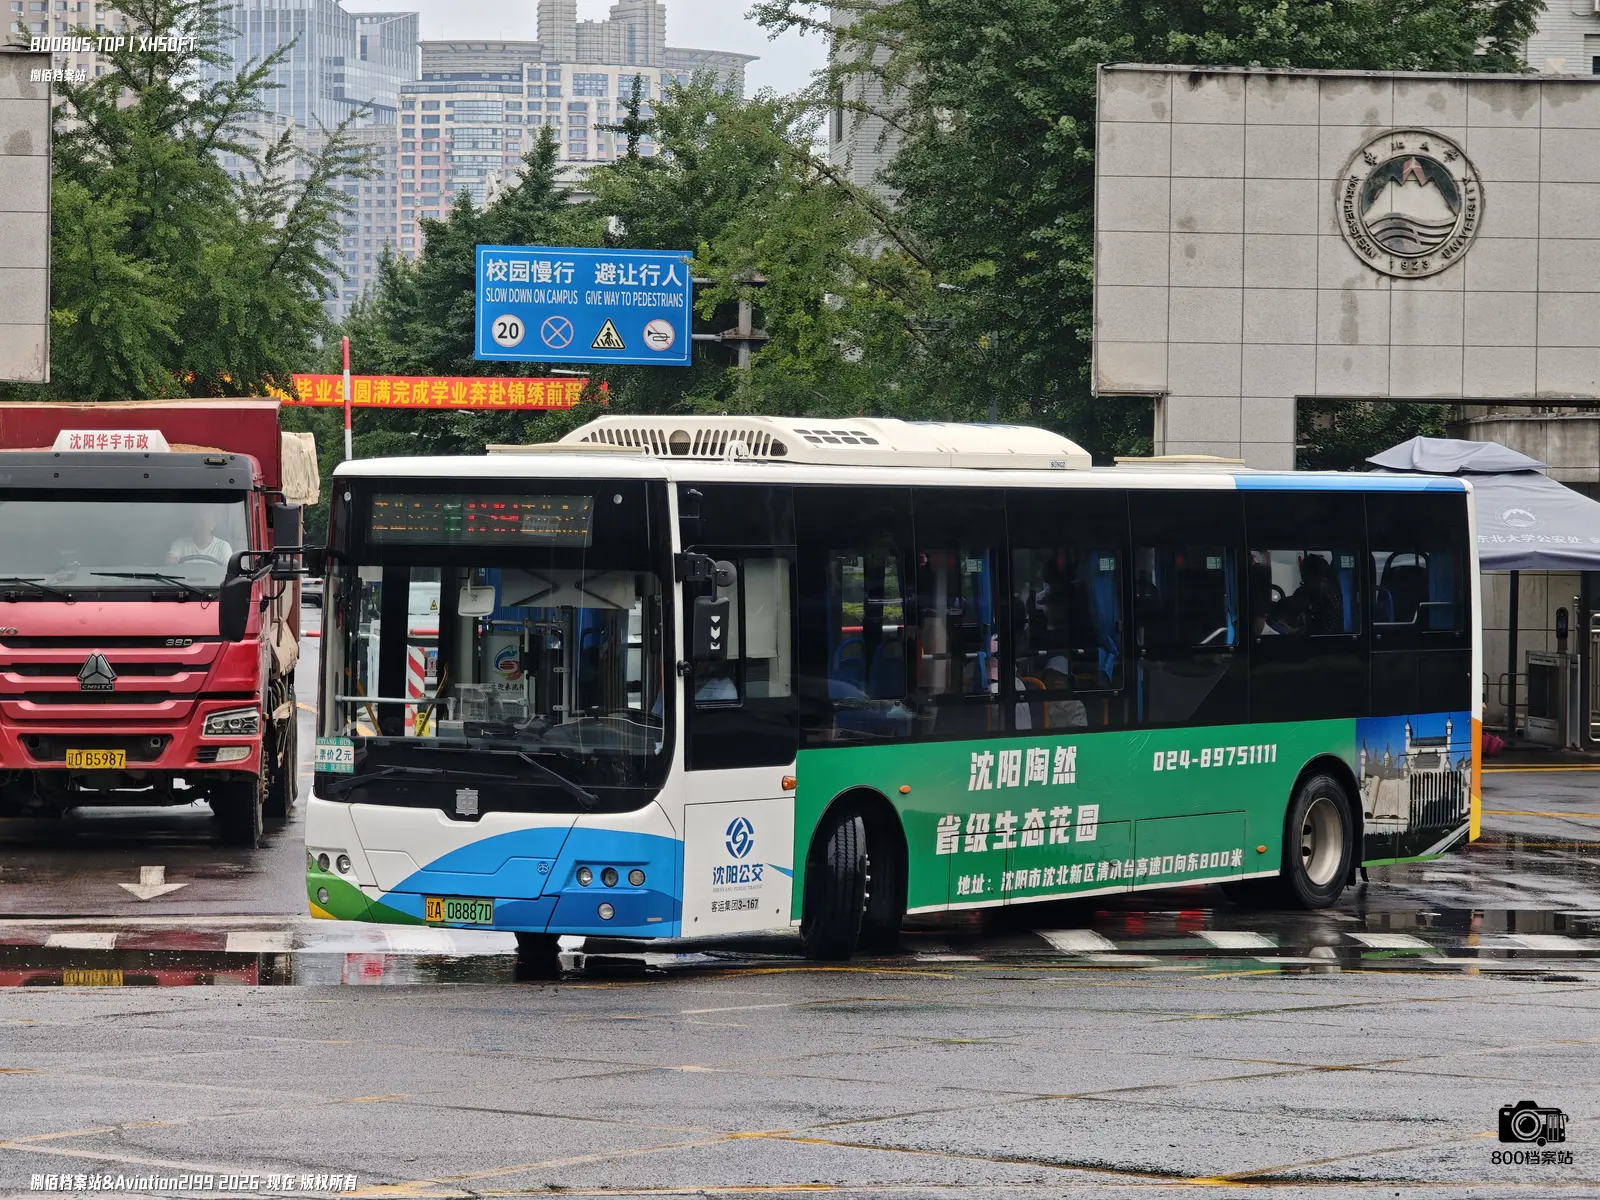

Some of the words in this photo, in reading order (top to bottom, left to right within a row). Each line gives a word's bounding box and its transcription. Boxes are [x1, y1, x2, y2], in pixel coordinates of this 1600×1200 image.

[486, 258, 575, 284] 校园慢行
[594, 262, 683, 288] 避让行人
[485, 287, 508, 302] SLOW
[508, 288, 533, 303] DOWN
[533, 288, 546, 304] ON
[546, 289, 578, 305] CAMPUS
[585, 290, 603, 305] GIVE
[603, 291, 620, 306] WAY
[621, 291, 632, 306] TO
[632, 292, 684, 308] PEDESTRIANS
[497, 322, 519, 340] 20
[69, 433, 149, 450] 沈阳华宇市政
[1477, 534, 1583, 544] 东北大学公安处
[165, 638, 193, 646] 380
[86, 752, 124, 767] B5987
[319, 748, 352, 762] 票价2元
[1153, 743, 1277, 772] 024-89751111
[967, 745, 1077, 791] 沈阳陶然
[935, 803, 1099, 855] 省级生态花园
[712, 863, 764, 885] 沈阳公交
[427, 901, 442, 918] 辽A
[447, 902, 492, 921] 08887D
